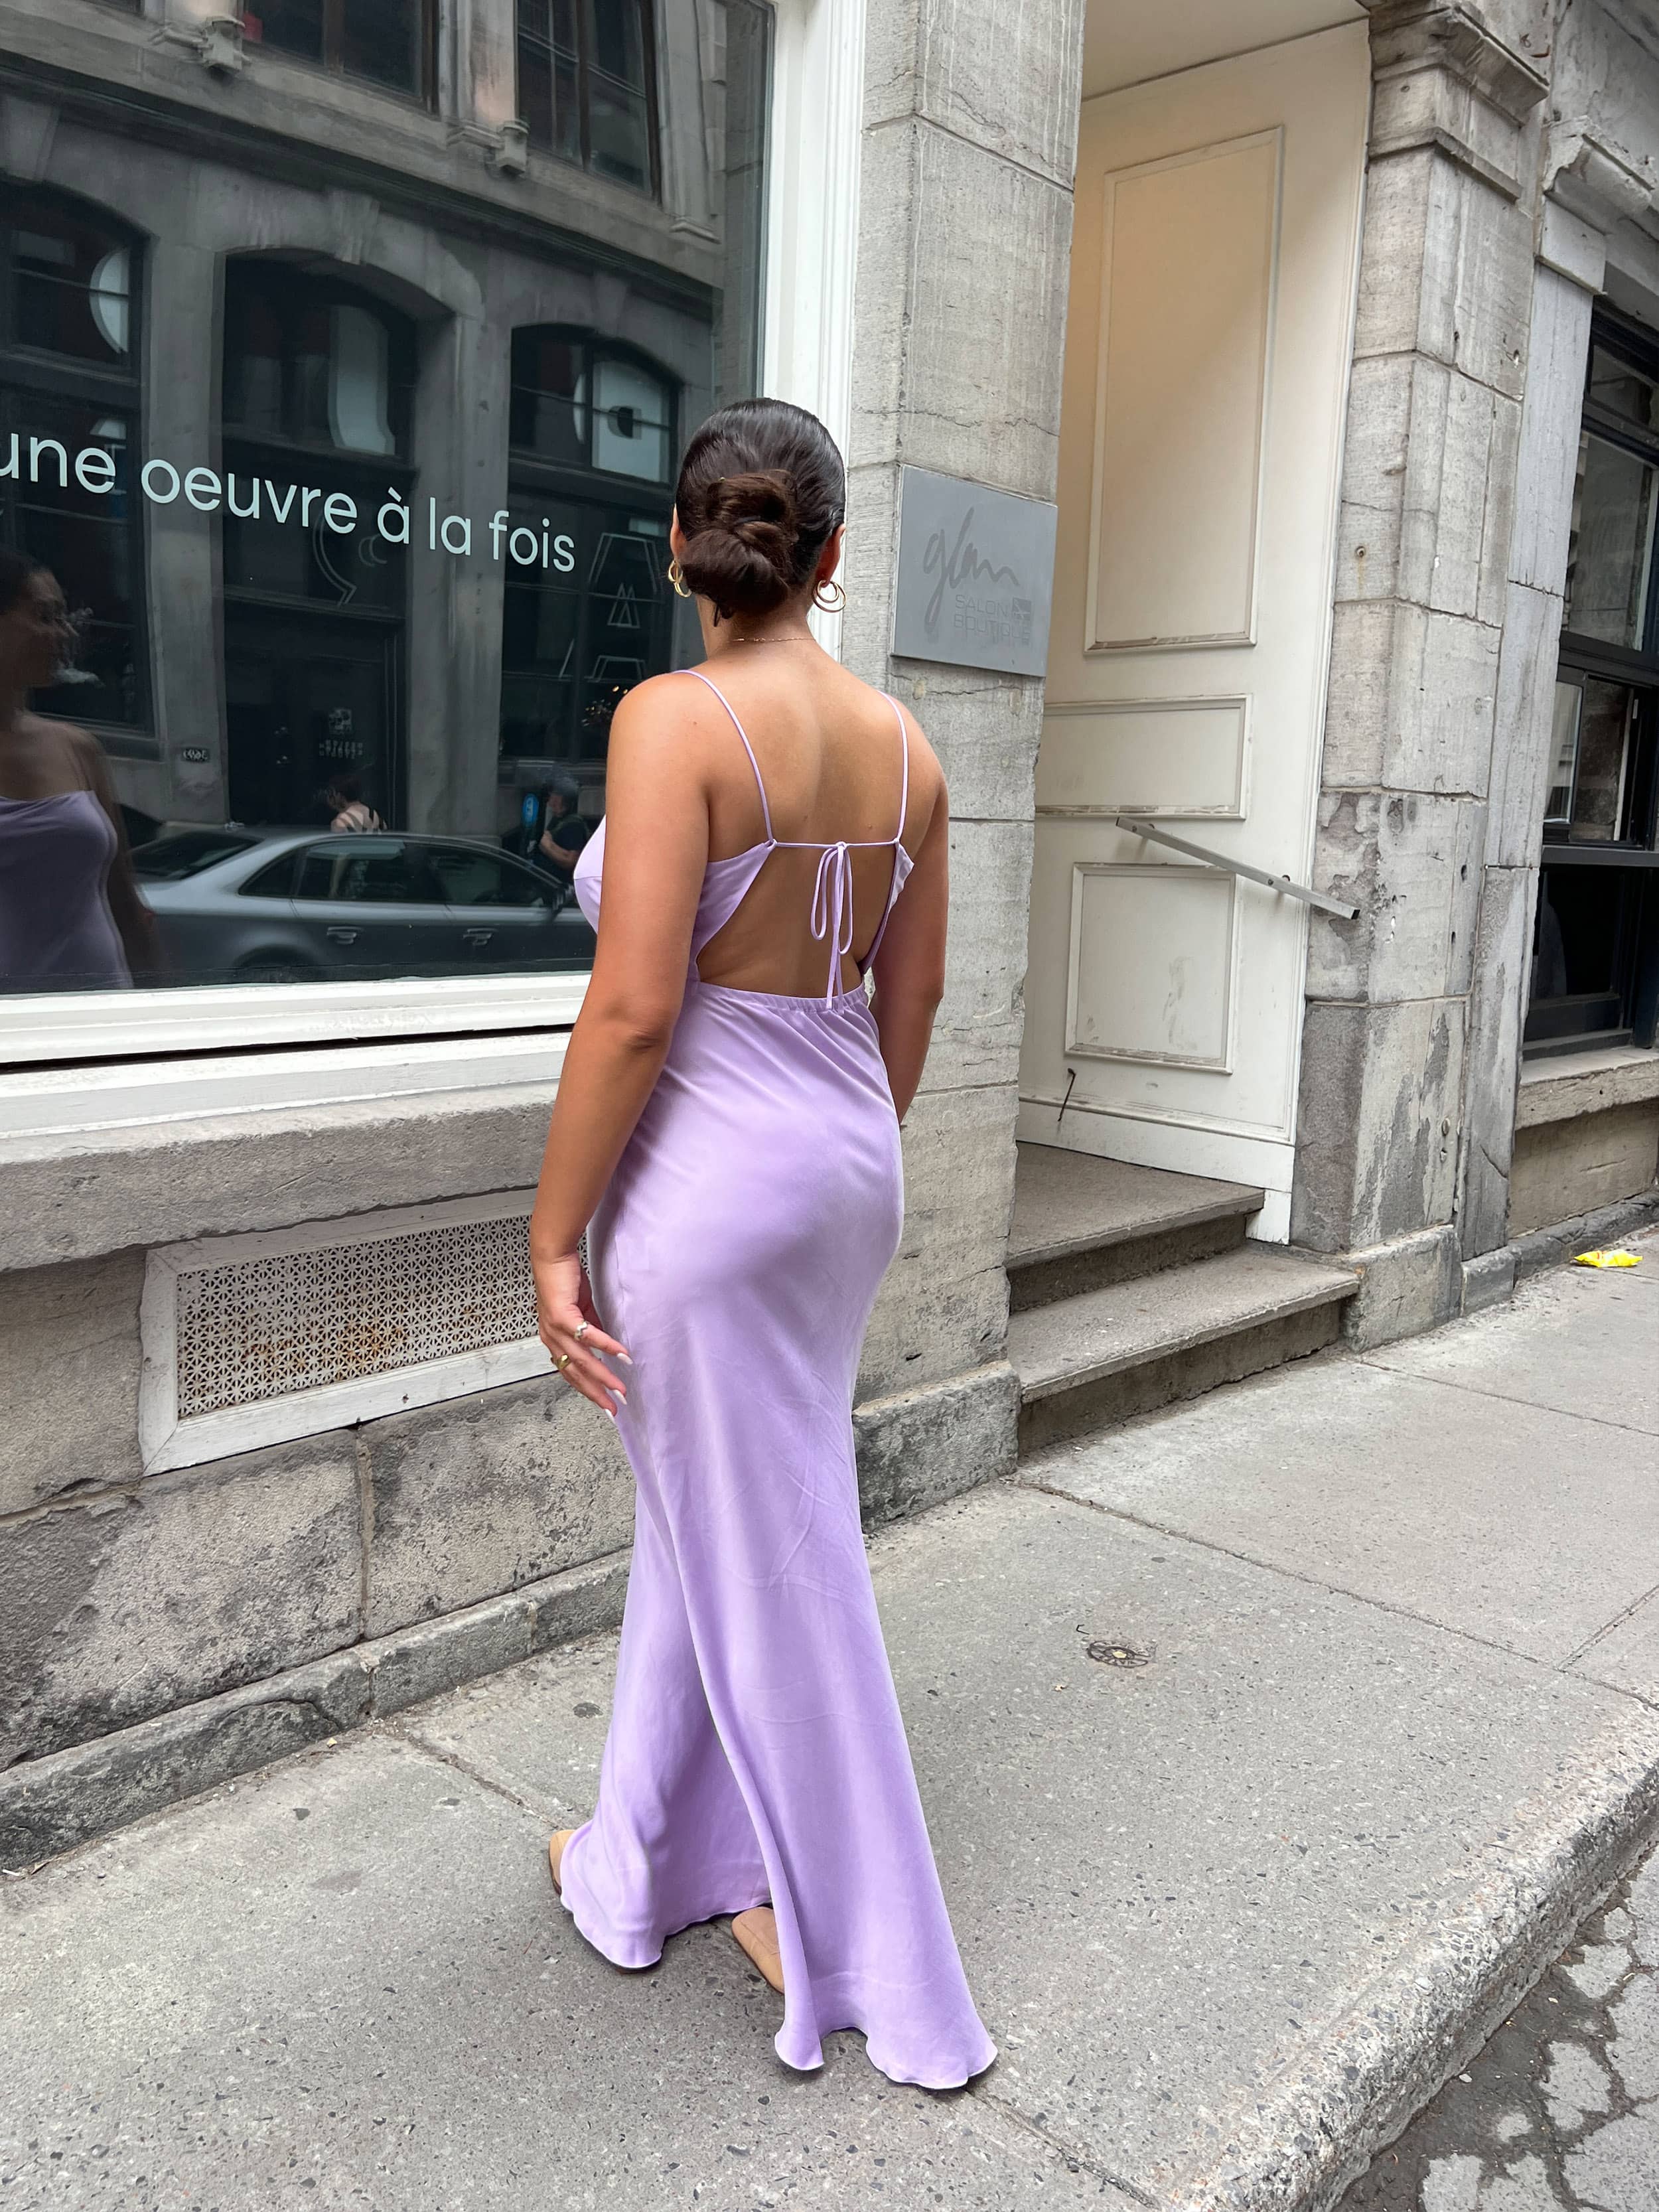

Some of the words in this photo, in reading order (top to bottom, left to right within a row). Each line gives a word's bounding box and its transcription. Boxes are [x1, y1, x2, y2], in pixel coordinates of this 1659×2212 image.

[141, 459, 357, 534] oeuvre
[378, 487, 410, 544] à
[429, 496, 471, 555] la
[488, 510, 575, 571] fois
[954, 594, 1010, 617] SALON
[953, 613, 1031, 641] BOUTIQUE
